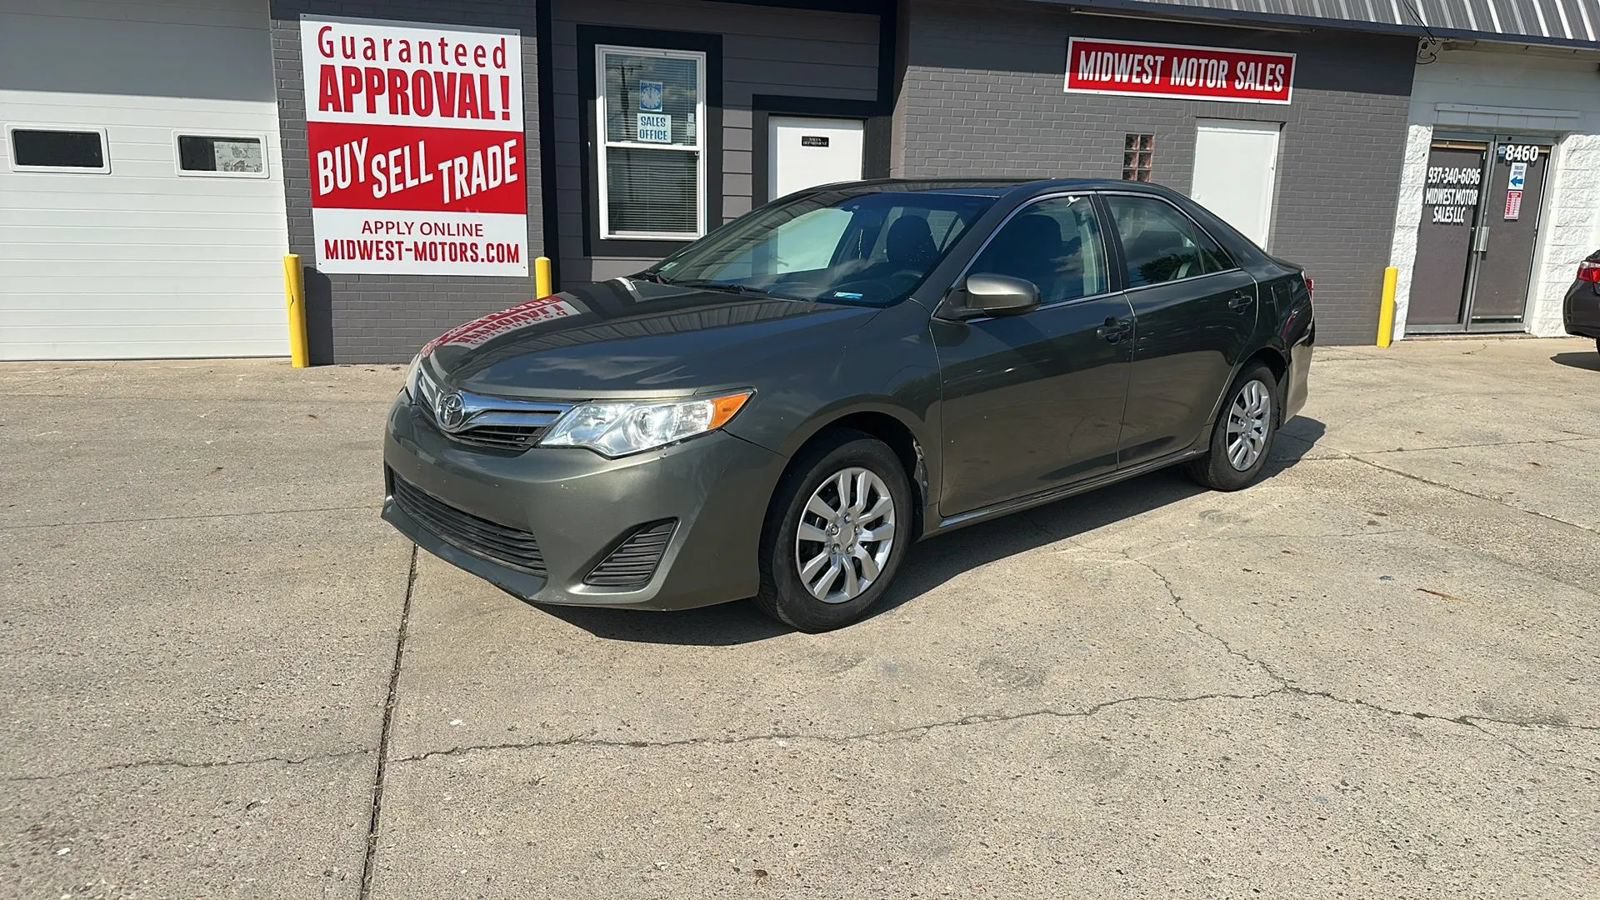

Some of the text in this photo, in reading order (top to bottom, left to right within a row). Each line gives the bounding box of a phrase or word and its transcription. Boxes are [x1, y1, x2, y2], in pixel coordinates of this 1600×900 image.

[317, 25, 507, 69] Guaranteed
[1077, 51, 1285, 93] MIDWEST MOTOR SALES
[318, 64, 511, 121] APPROVAL!
[640, 116, 666, 128] SALES
[639, 129, 668, 140] OFFICE
[1505, 145, 1539, 162] 8460
[317, 136, 369, 196] BUY
[371, 140, 434, 199] SELL
[438, 139, 518, 205] TRADE
[1428, 166, 1480, 185] 937-340-6096
[1425, 187, 1478, 206] MIDWEST MOTOR
[1432, 206, 1466, 223] SALES LLC
[361, 220, 484, 237] APPLY ONLINE
[324, 238, 520, 264] MIDWEST-MOTORS.COM
